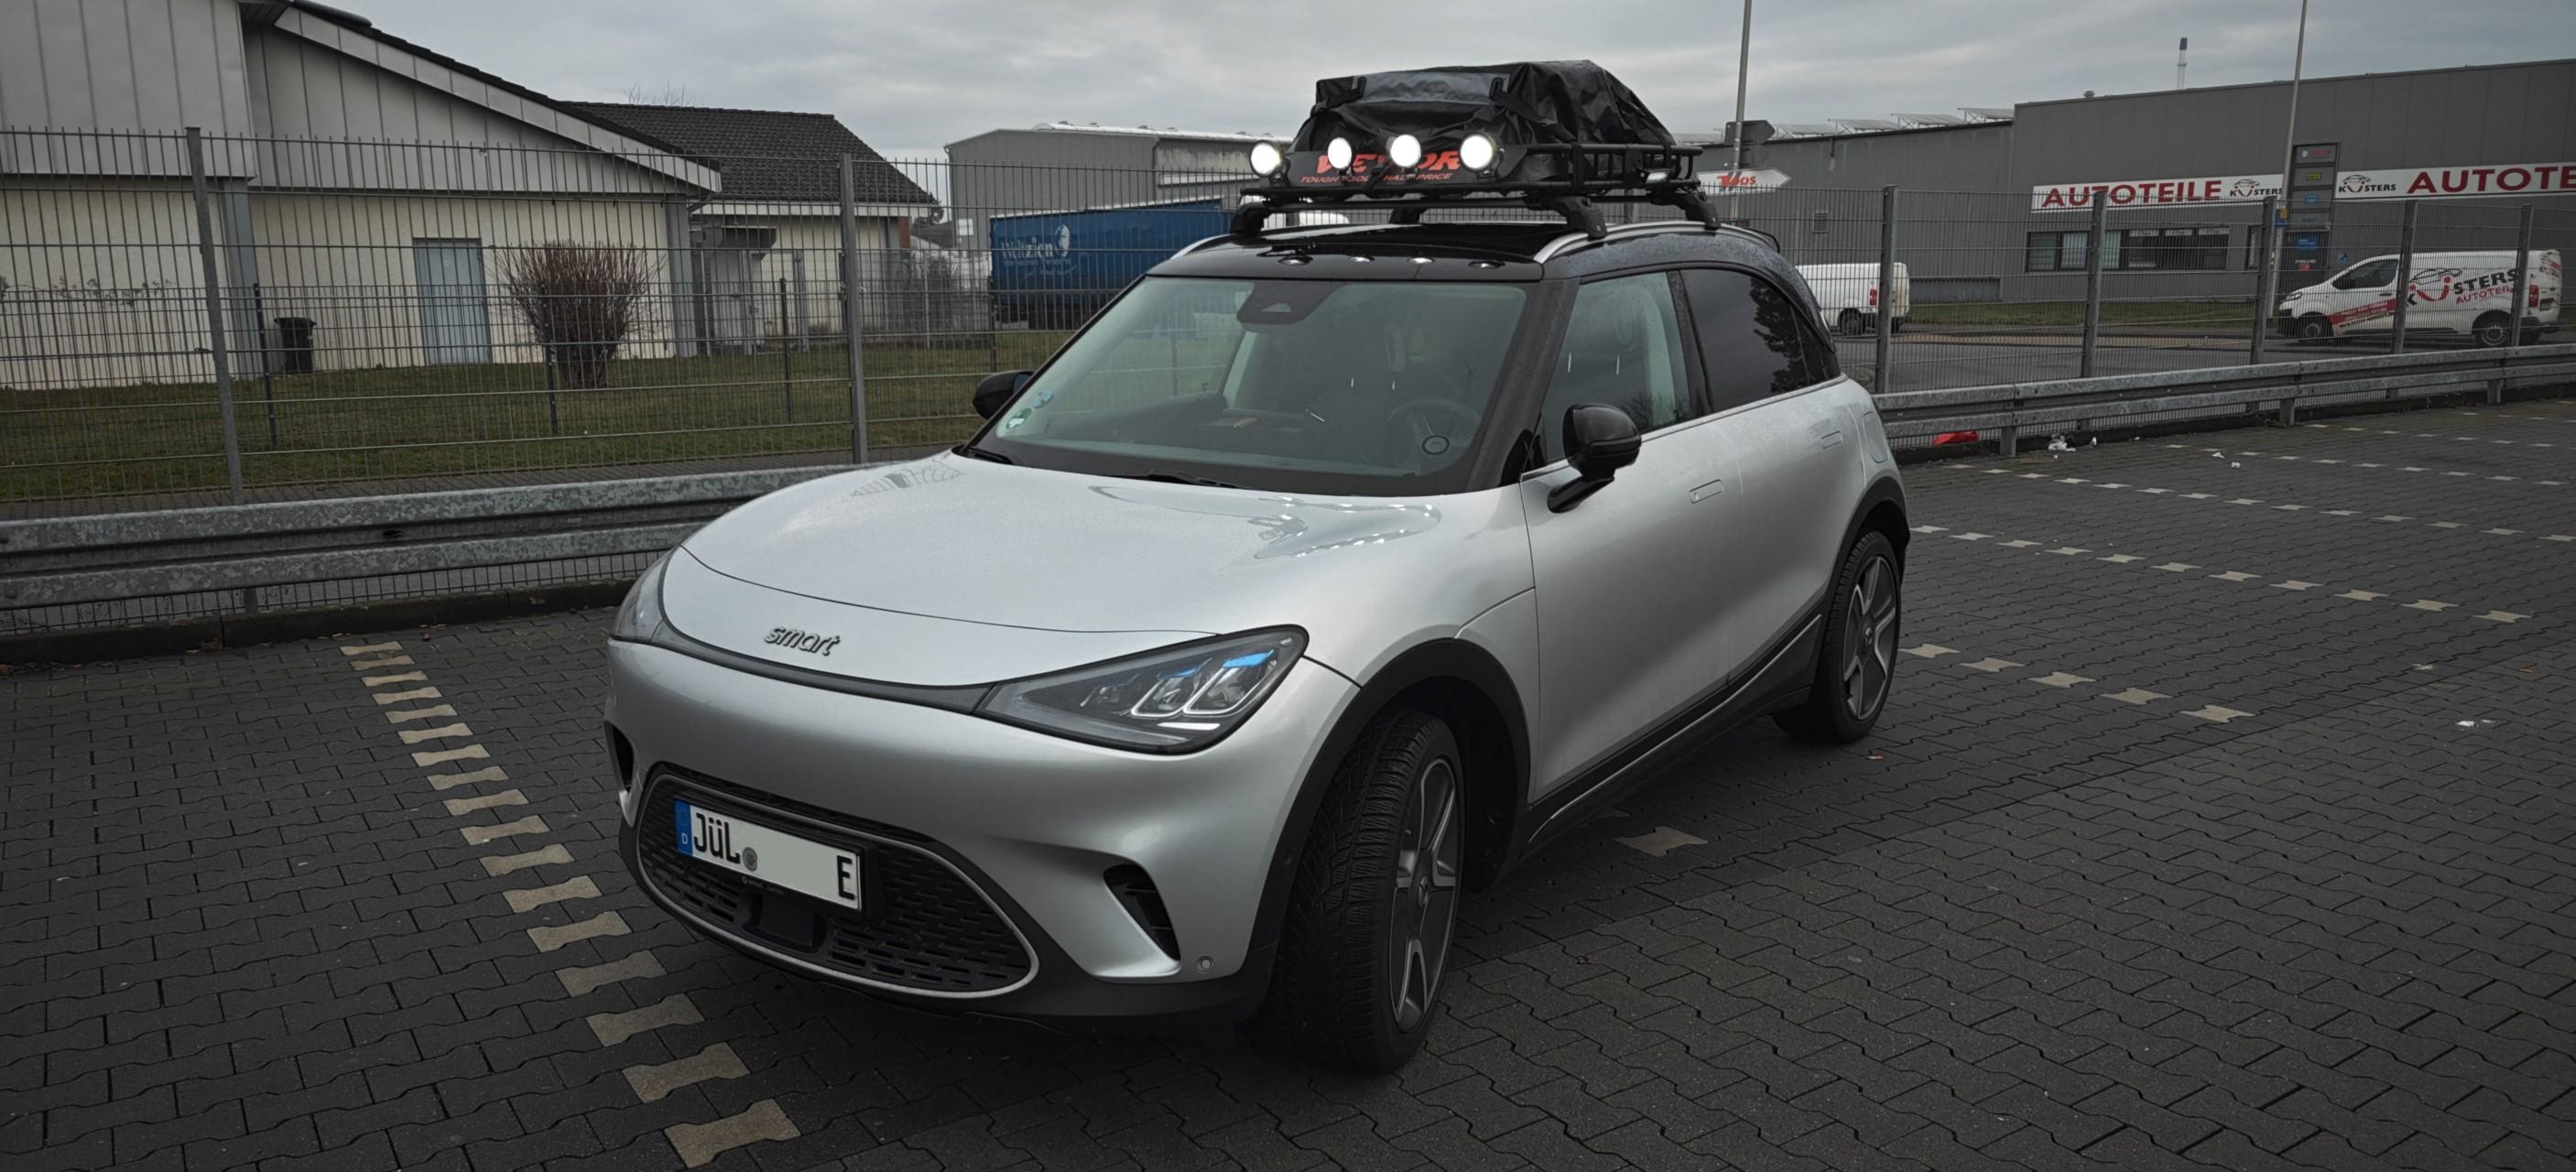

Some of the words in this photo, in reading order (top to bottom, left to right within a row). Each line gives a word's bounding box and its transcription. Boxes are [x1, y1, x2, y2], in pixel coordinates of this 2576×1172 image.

[1317, 150, 1461, 173] VEOR
[1417, 172, 1453, 180] PRICE
[2456, 285, 2518, 304] AUTOTEIL
[766, 626, 840, 657] smart
[681, 832, 689, 845] D
[836, 854, 856, 900] E
